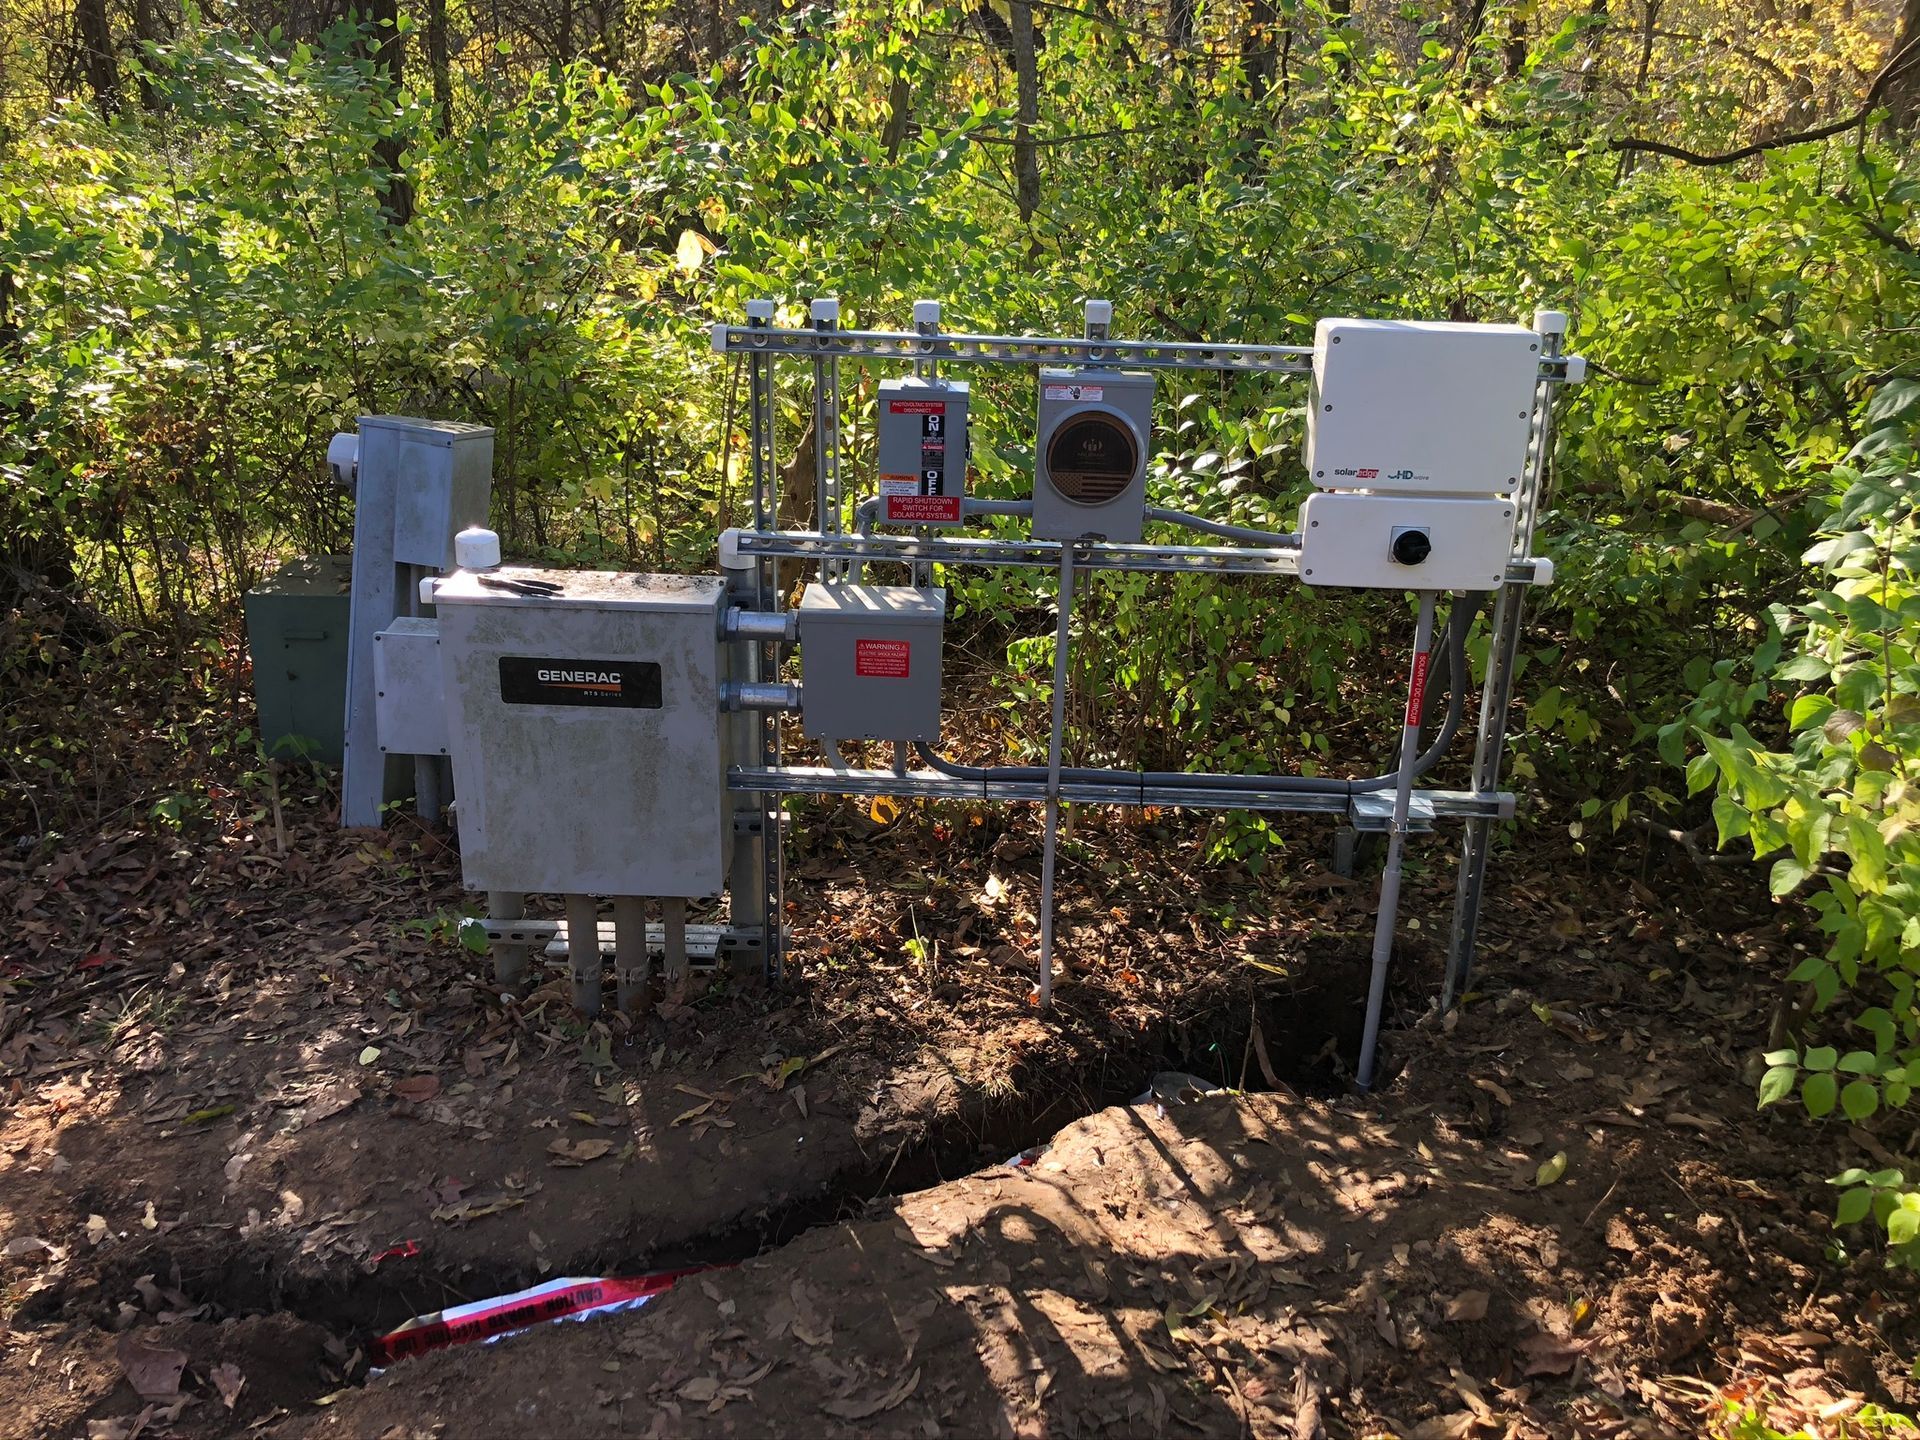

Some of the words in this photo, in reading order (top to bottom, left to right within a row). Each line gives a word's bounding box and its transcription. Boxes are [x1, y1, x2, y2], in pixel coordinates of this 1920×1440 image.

[928, 415, 939, 432] ON
[927, 470, 938, 496] OFF
[893, 496, 913, 504] RAPID
[914, 497, 953, 505] SHUTDOWN
[927, 512, 953, 520] SYSTEM
[1417, 656, 1427, 678] SOLAR
[537, 669, 622, 684] GENERAC
[1416, 678, 1424, 687] PV
[1414, 687, 1422, 697] DC
[1410, 697, 1420, 724] CIRCUIT
[546, 1287, 603, 1314] CAUTION
